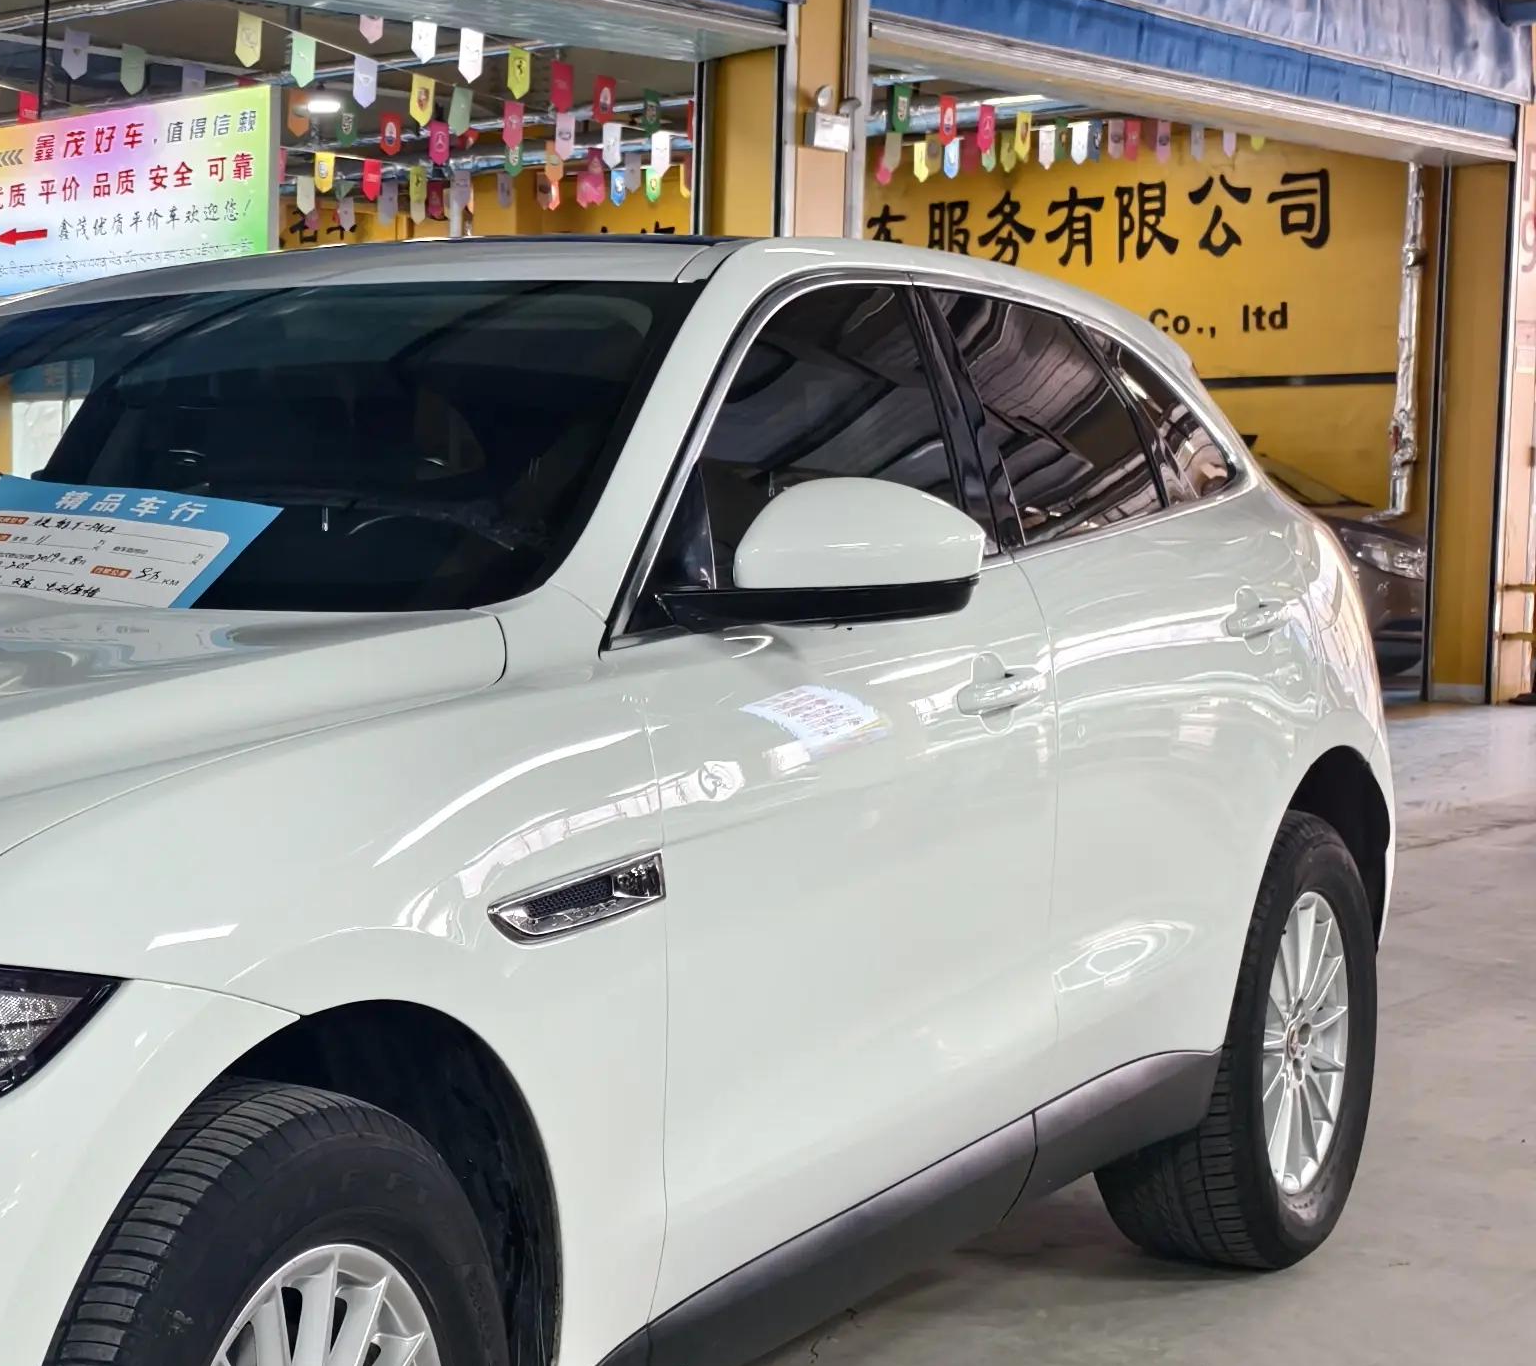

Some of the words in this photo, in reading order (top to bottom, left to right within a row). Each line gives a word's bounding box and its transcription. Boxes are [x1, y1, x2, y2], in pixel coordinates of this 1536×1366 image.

[39, 176, 80, 205] 平价
[93, 169, 136, 198] 品质
[149, 161, 194, 191] 安全
[207, 152, 254, 183] 可靠
[1241, 301, 1289, 333] ltd
[54, 490, 209, 523] 精品车行
[161, 579, 180, 587] KM
